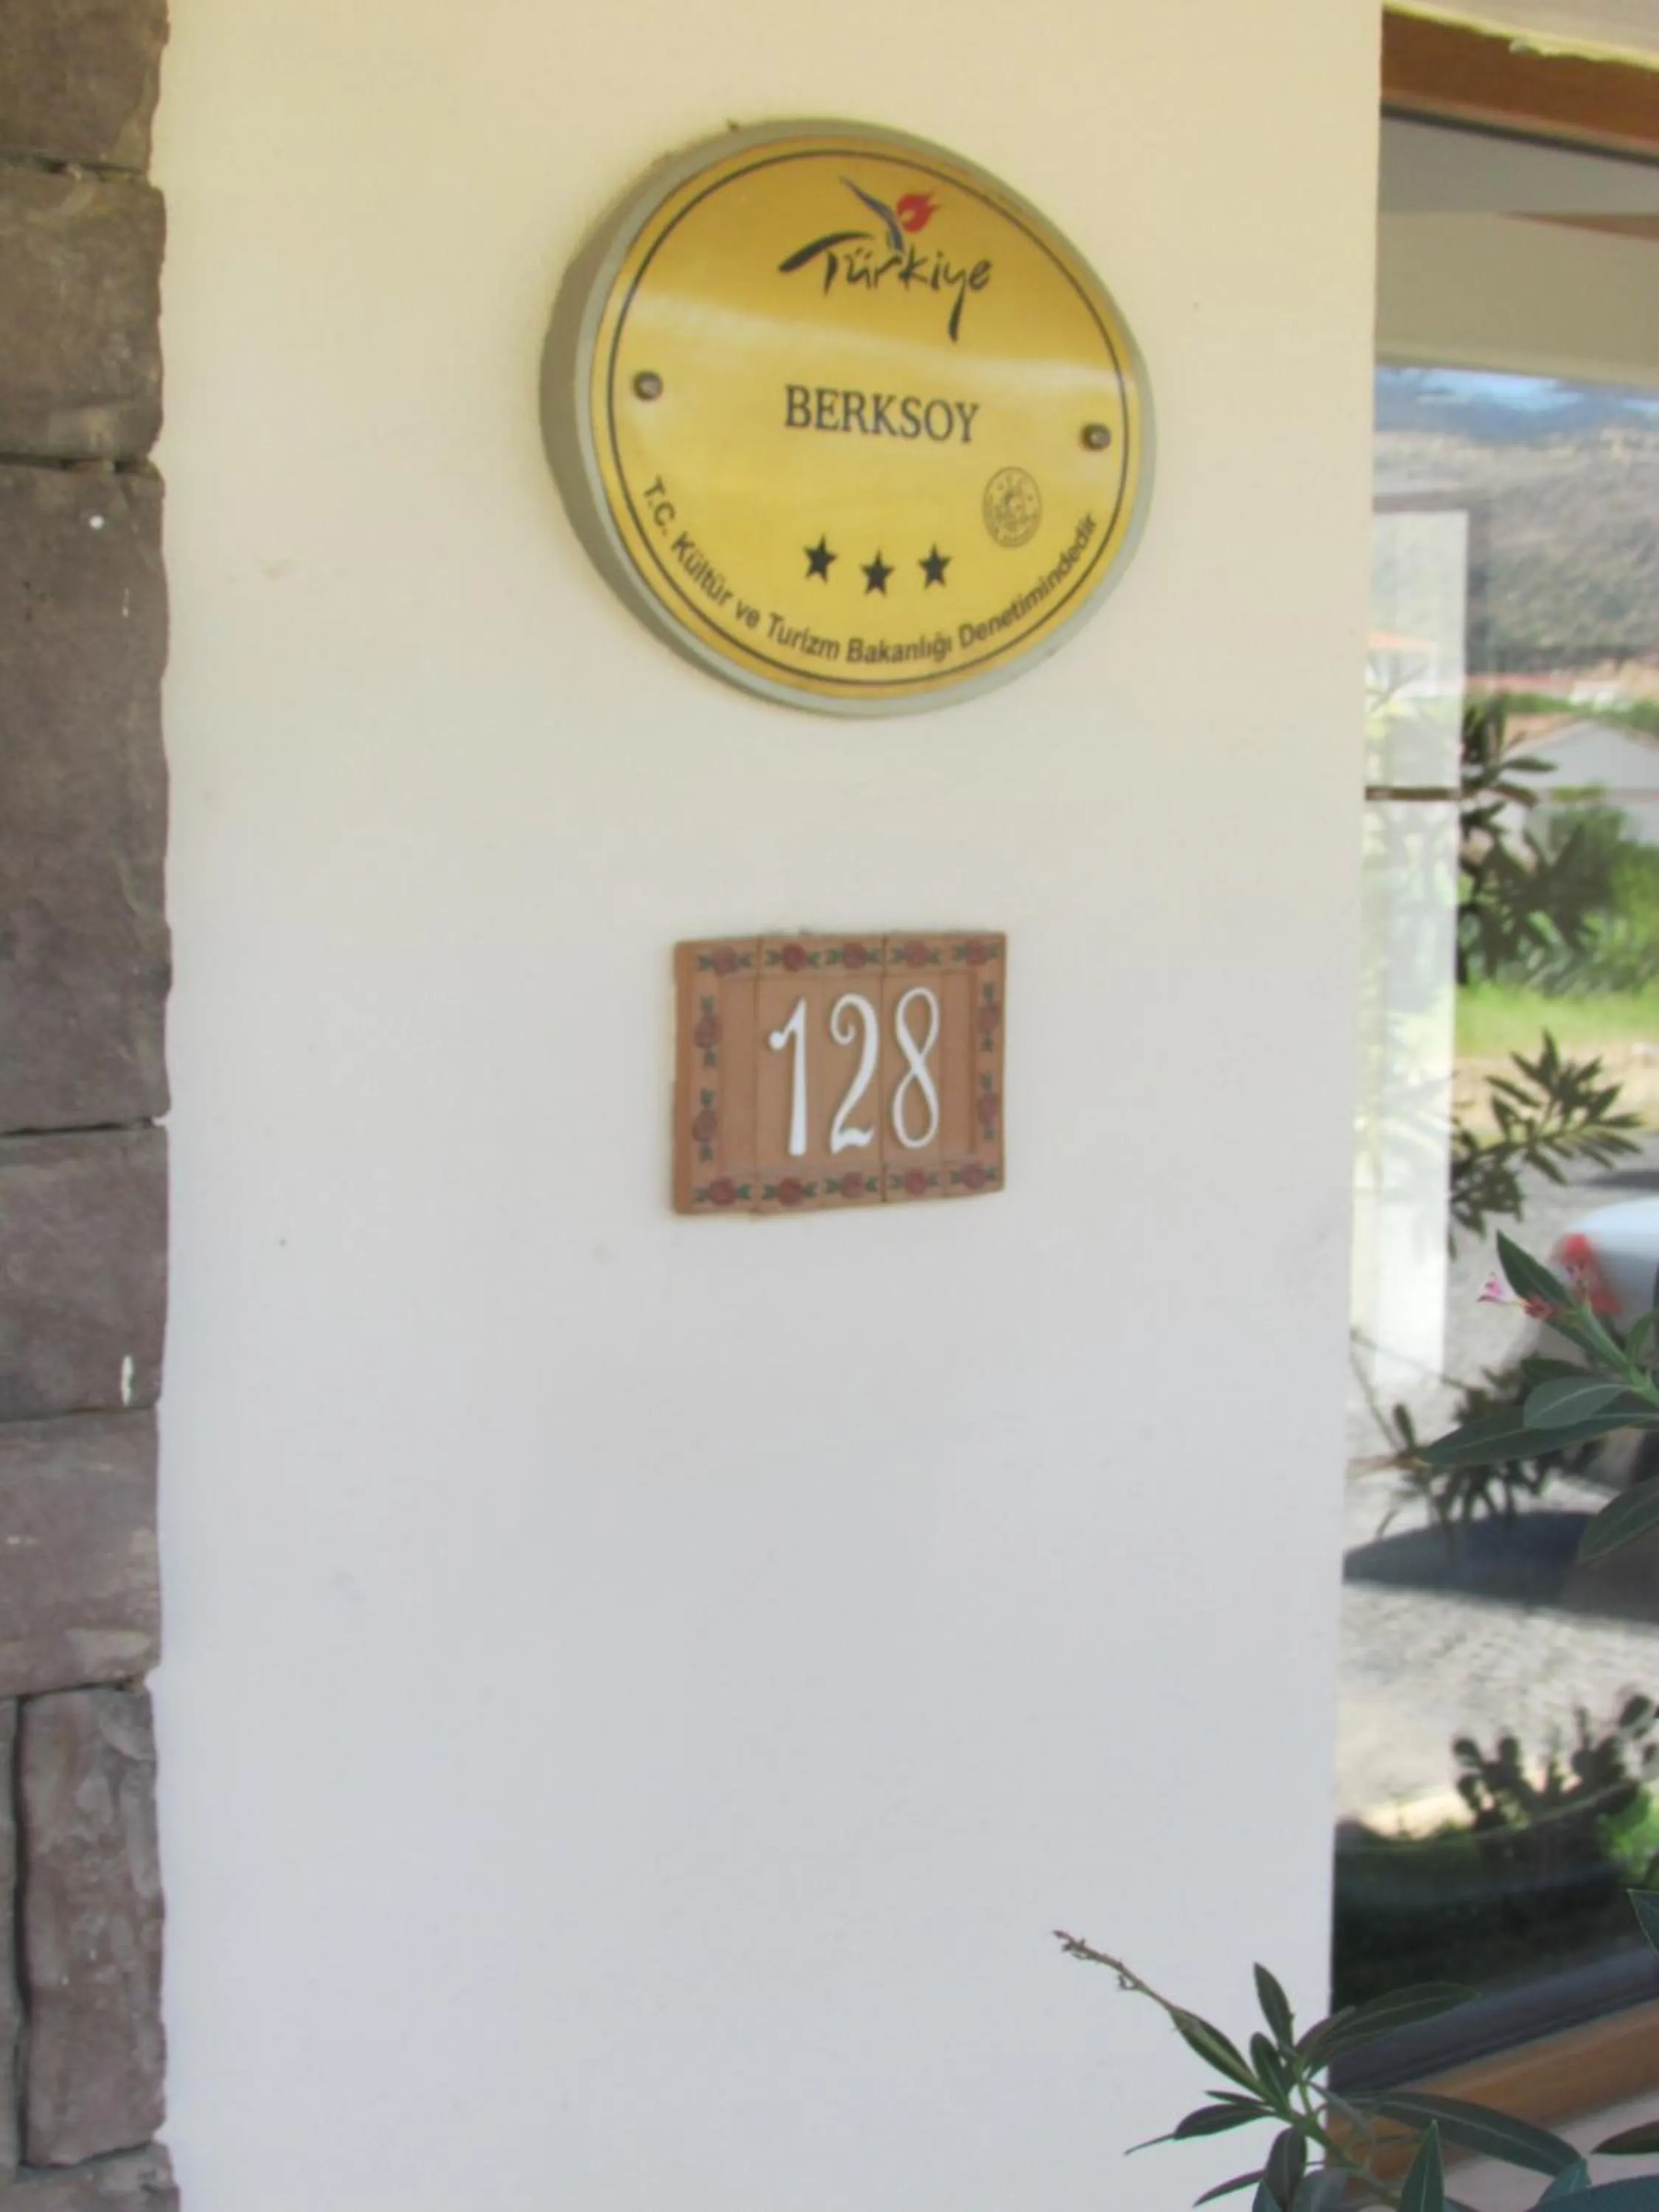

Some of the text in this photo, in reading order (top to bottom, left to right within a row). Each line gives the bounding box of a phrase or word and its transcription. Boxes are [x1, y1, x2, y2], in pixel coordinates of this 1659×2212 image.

[778, 230, 992, 344] Türkiye
[785, 383, 980, 444] BERKSOY
[643, 473, 1097, 664] T.C. Kültür ve Turizm Bakanlığı Denetimindedir
[768, 986, 941, 1157] 128
